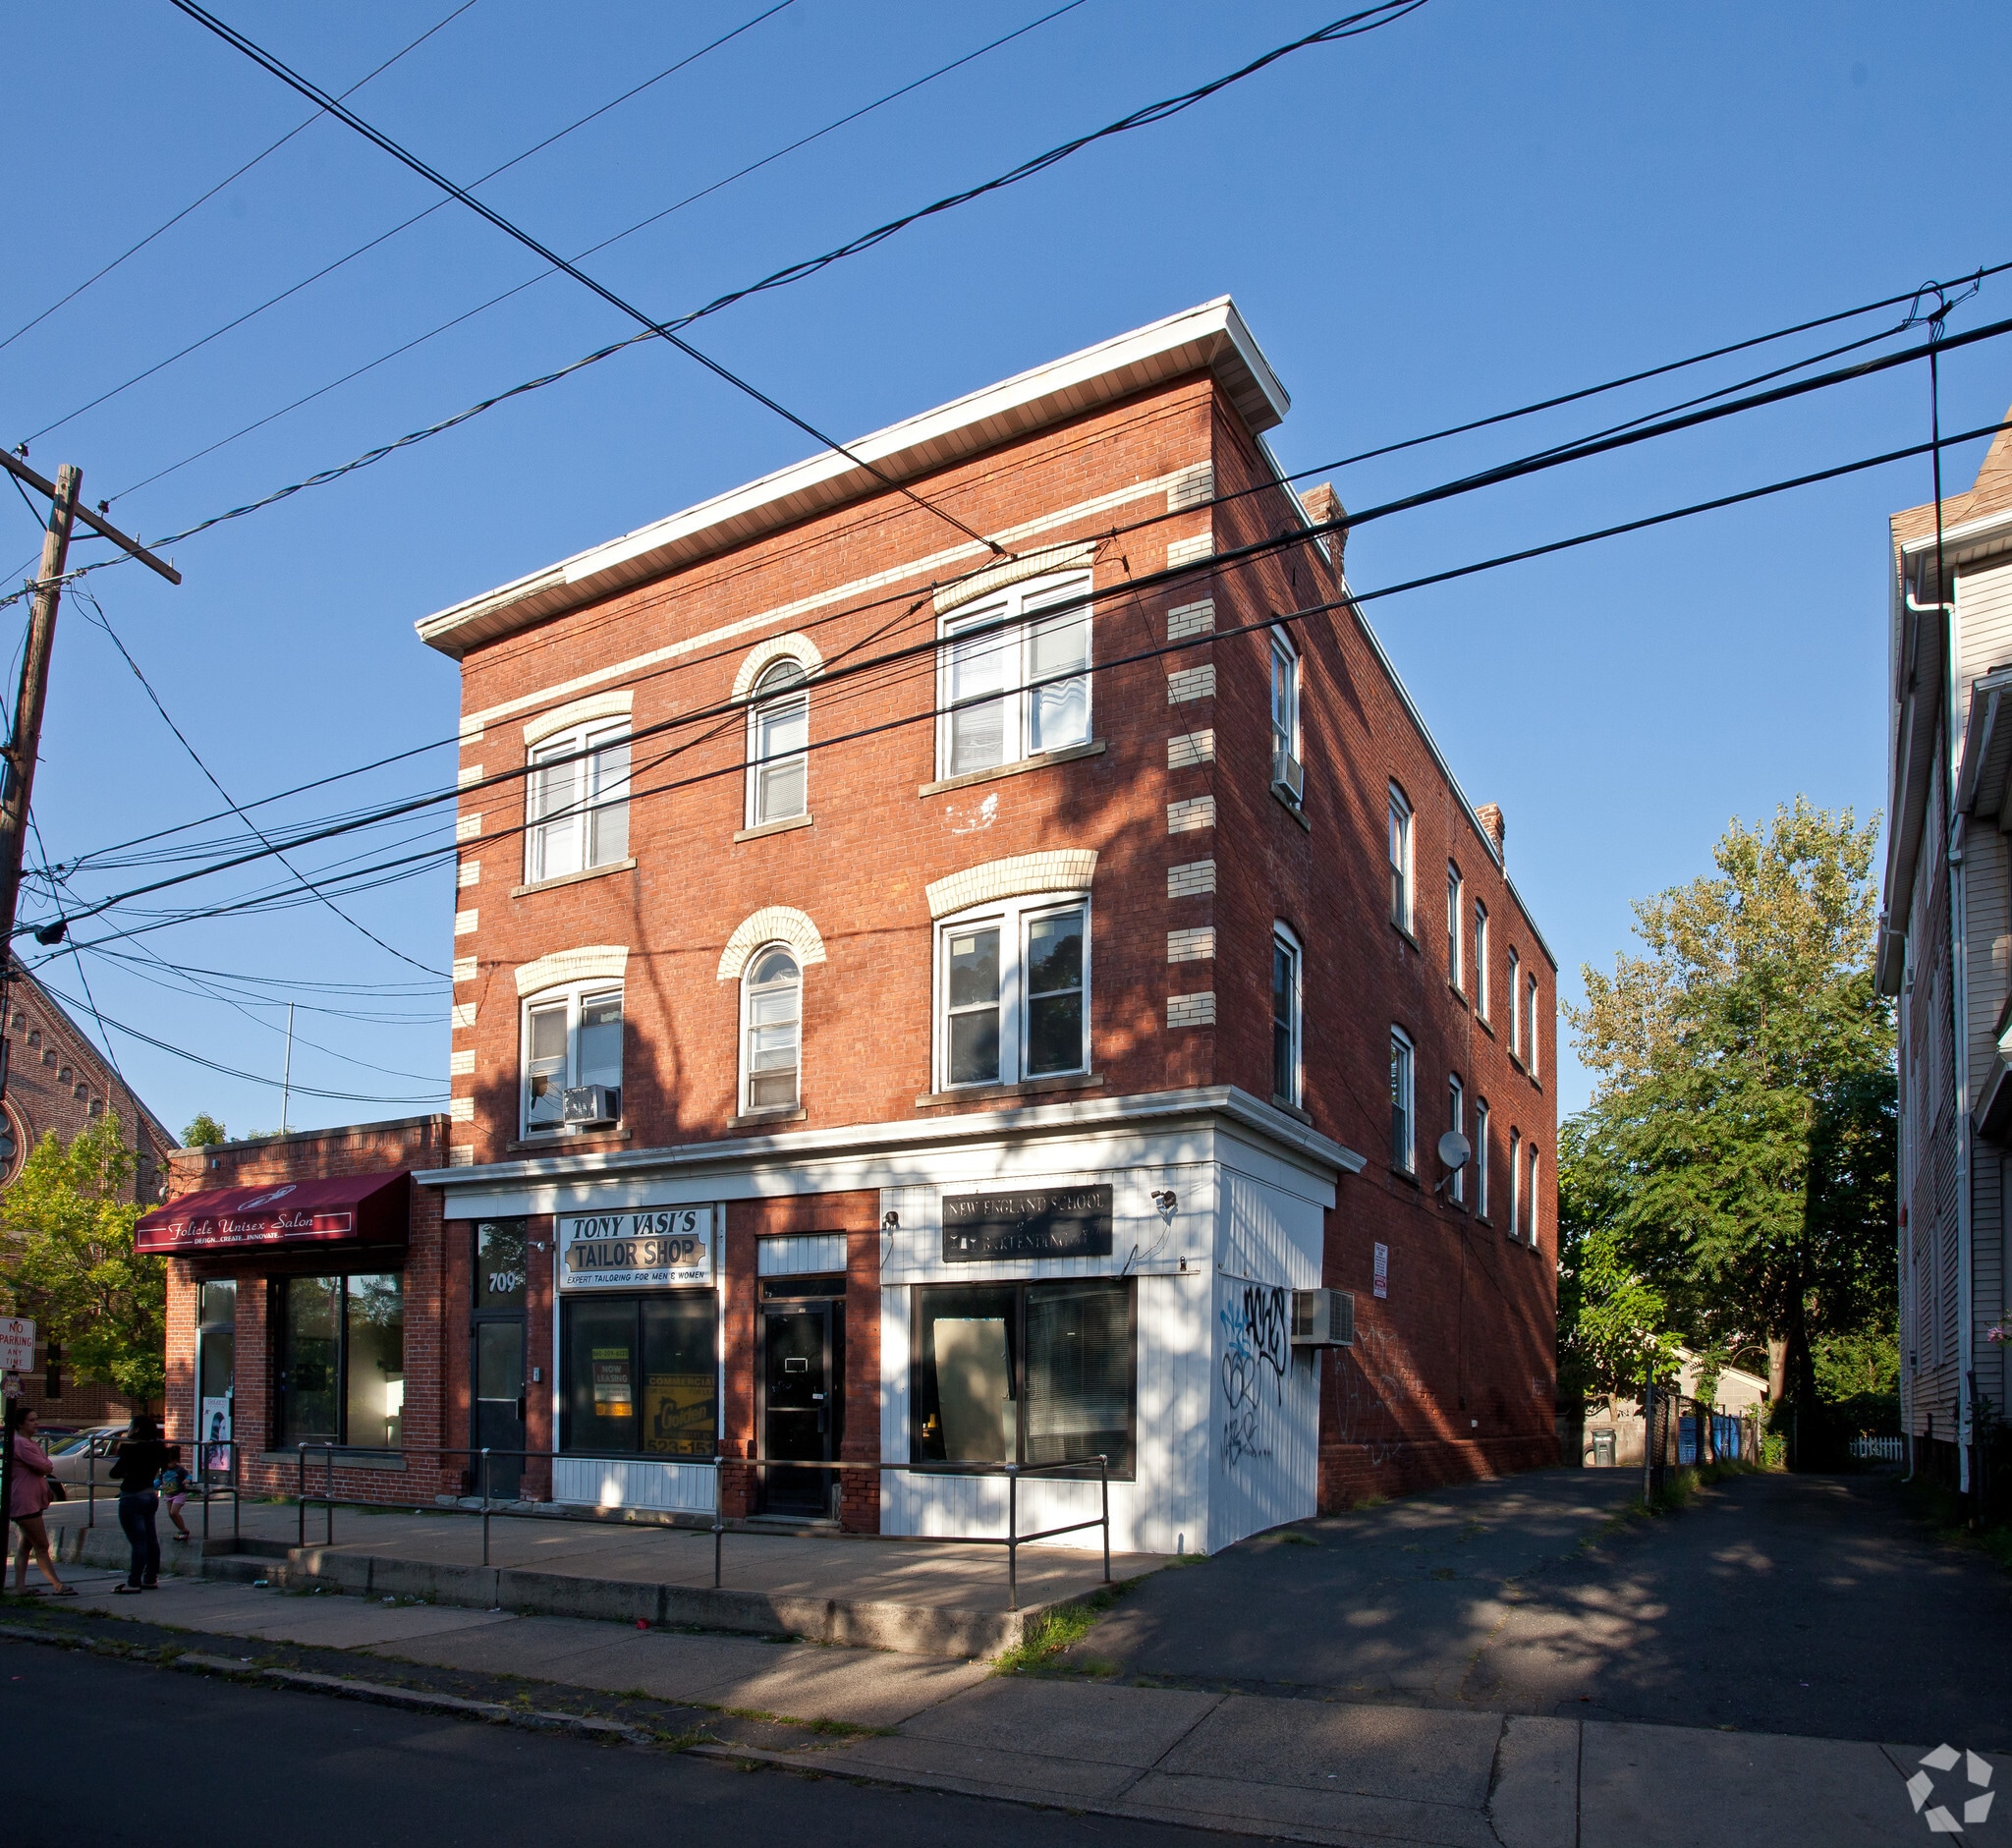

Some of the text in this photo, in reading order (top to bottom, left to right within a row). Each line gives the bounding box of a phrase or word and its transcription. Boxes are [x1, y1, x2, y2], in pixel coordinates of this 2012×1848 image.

[949, 1193, 1104, 1217] NEW ENGLAND SCHOOL
[168, 1211, 313, 1241] Folicle Unisex Salon
[573, 1210, 697, 1239] TONY VASI'S
[575, 1239, 696, 1268] TAILOR SHOP
[487, 1272, 517, 1294] 709
[567, 1275, 593, 1284] EXPERT
[593, 1273, 632, 1283] TAILORING
[635, 1272, 649, 1281] FOR
[651, 1271, 668, 1280] MEN
[677, 1270, 705, 1280] WOMEN
[9, 1322, 24, 1333] NO
[0, 1334, 32, 1347] PARKING
[6, 1358, 24, 1367] TIME
[602, 1365, 622, 1373] NOW
[597, 1374, 628, 1383] LEASING
[661, 1403, 707, 1430] Golden
